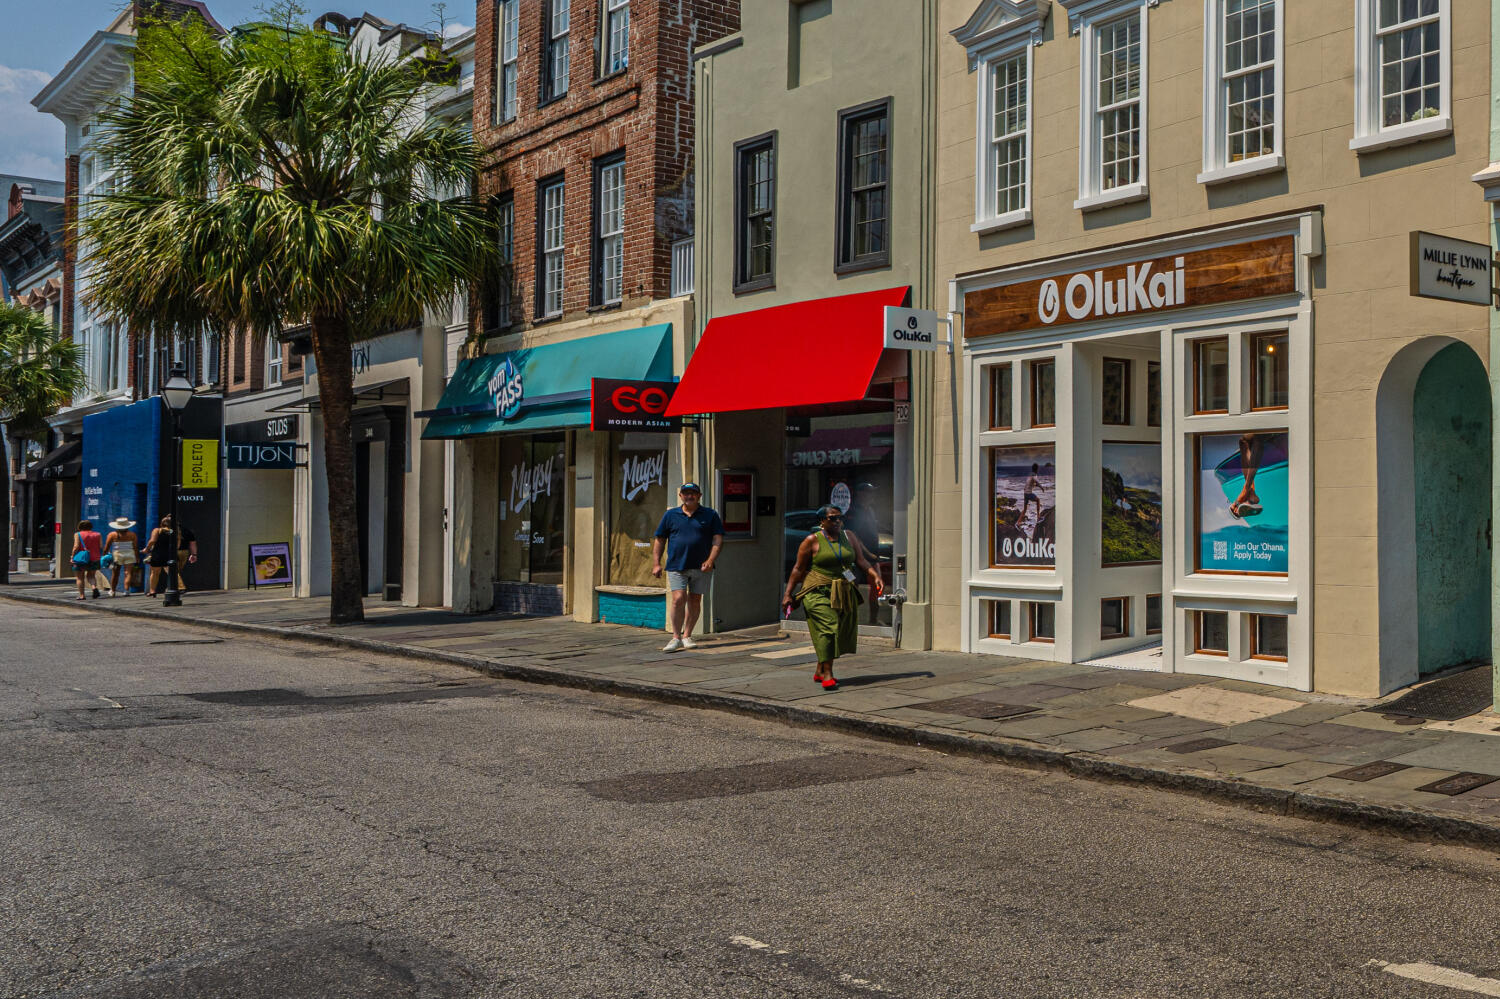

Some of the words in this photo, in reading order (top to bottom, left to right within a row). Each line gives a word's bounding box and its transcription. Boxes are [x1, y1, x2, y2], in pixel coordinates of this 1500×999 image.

[1423, 248, 1458, 267] MILLIE
[1460, 254, 1487, 271] LYNN
[1064, 256, 1185, 320] OluKai
[1436, 268, 1476, 290] boutique
[893, 329, 932, 343] OluKai
[488, 368, 506, 396] vom
[496, 374, 523, 418] FASS
[267, 418, 288, 437] STUDS
[192, 443, 203, 484] SPOLETO
[622, 451, 665, 500] Mugsy
[510, 455, 554, 513] Mugsy
[1233, 541, 1246, 550] Join
[1247, 542, 1259, 551] Our
[1233, 551, 1252, 561] Apply
[1253, 551, 1272, 562] Today
